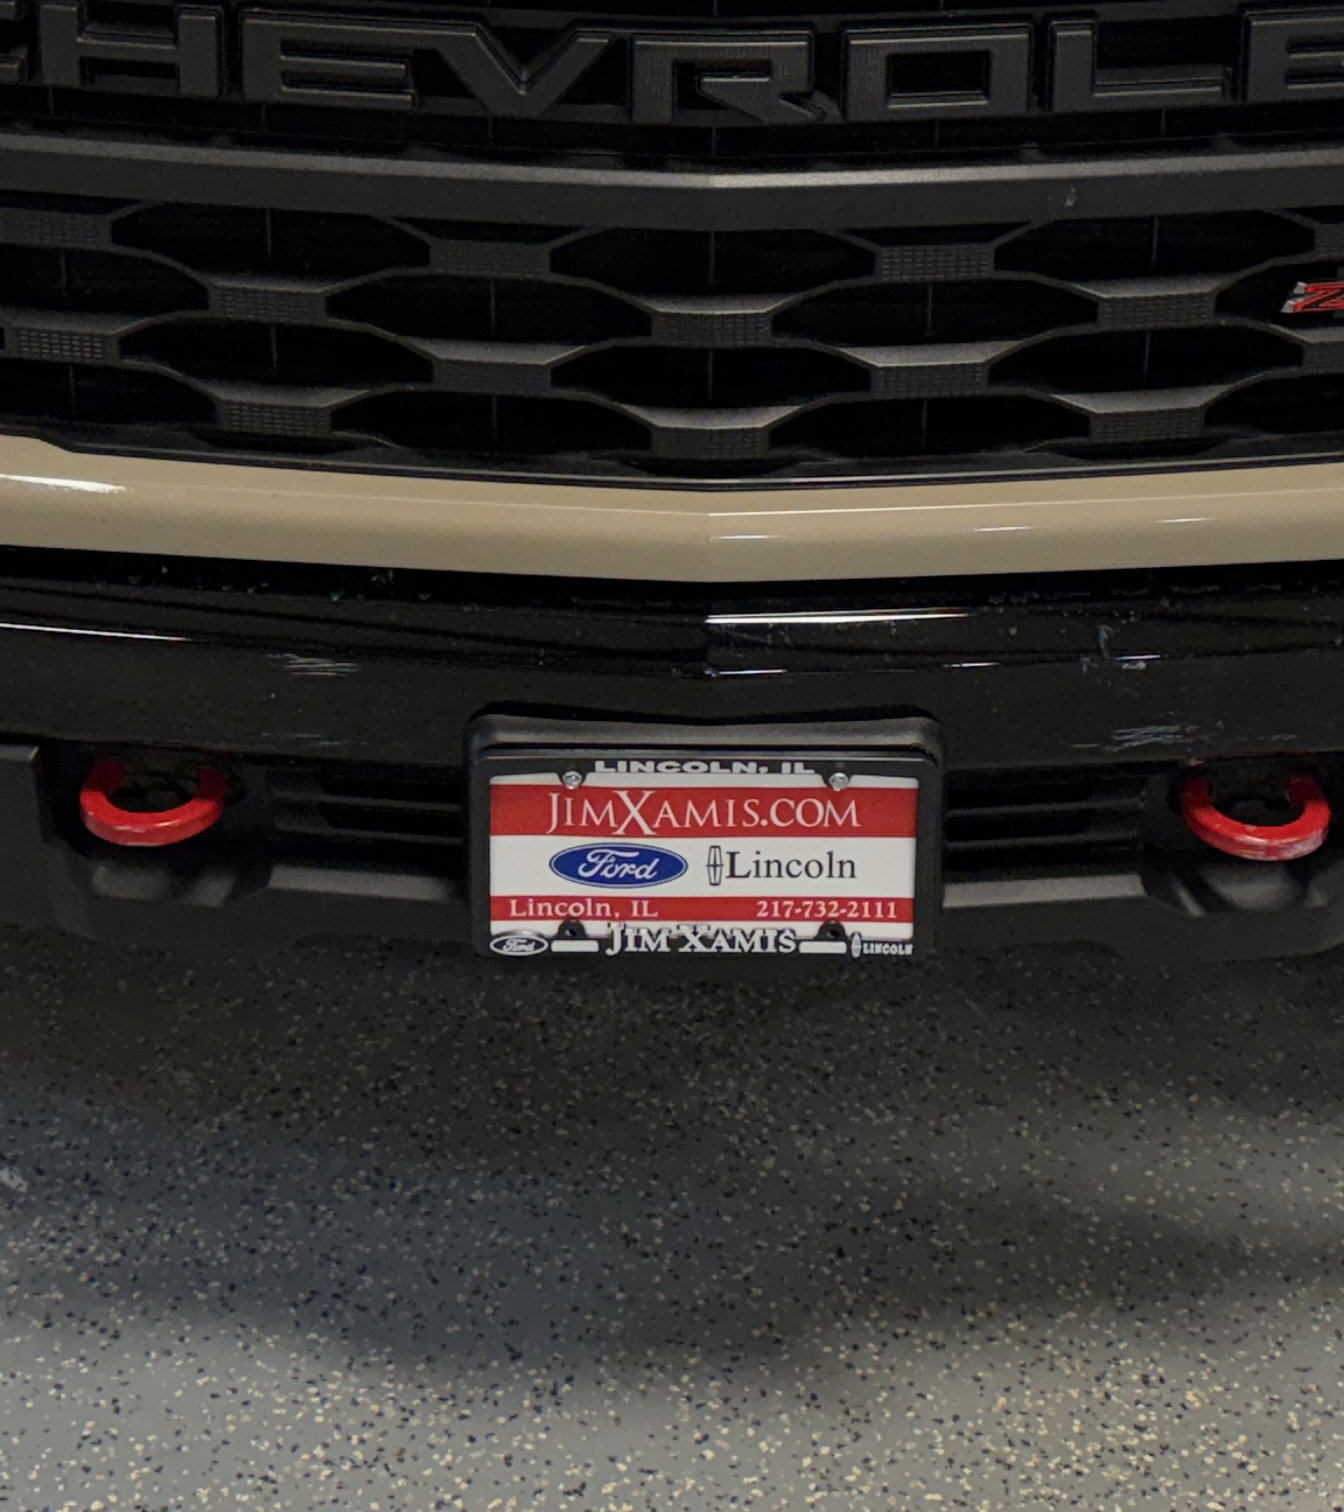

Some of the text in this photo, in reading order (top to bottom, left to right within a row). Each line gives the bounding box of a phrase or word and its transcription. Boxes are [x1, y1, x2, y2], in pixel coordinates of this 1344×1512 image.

[595, 760, 816, 774] LINCOLN, IL
[546, 790, 861, 835] JIMXAMIS.COM
[577, 848, 856, 881] Ford Lincoln
[509, 898, 659, 918] Lincoln, IL
[756, 900, 897, 919] 217-732-2111
[502, 938, 536, 953] Ford
[606, 924, 797, 956] JIM XAMIS
[862, 943, 913, 956] LINCOLN
